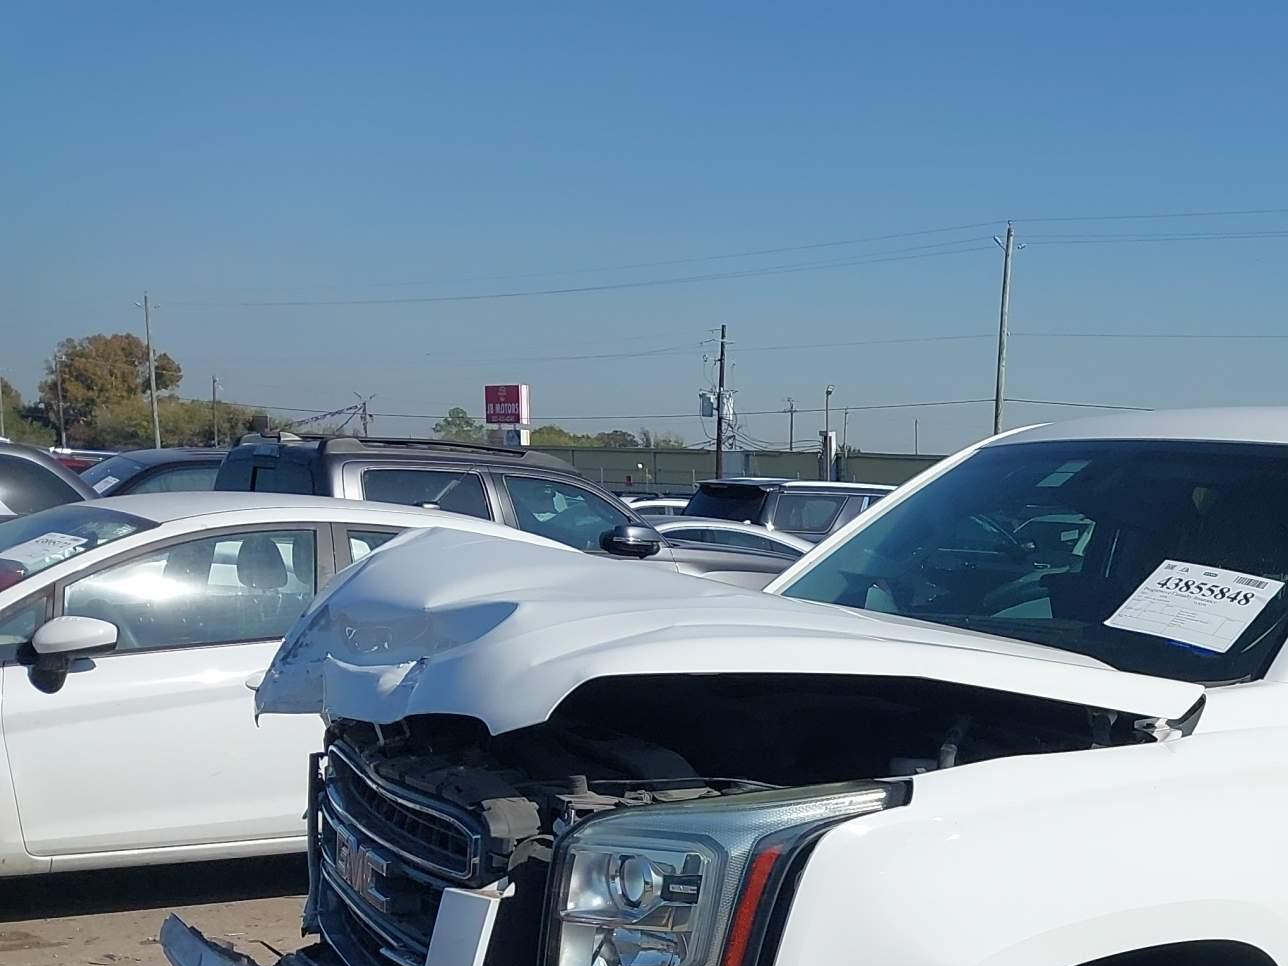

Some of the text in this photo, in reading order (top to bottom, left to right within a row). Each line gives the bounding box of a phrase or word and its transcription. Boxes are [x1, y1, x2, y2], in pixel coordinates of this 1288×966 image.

[495, 402, 519, 414] MOTORS
[1157, 576, 1255, 606] 43855848
[336, 824, 391, 913] GMC
